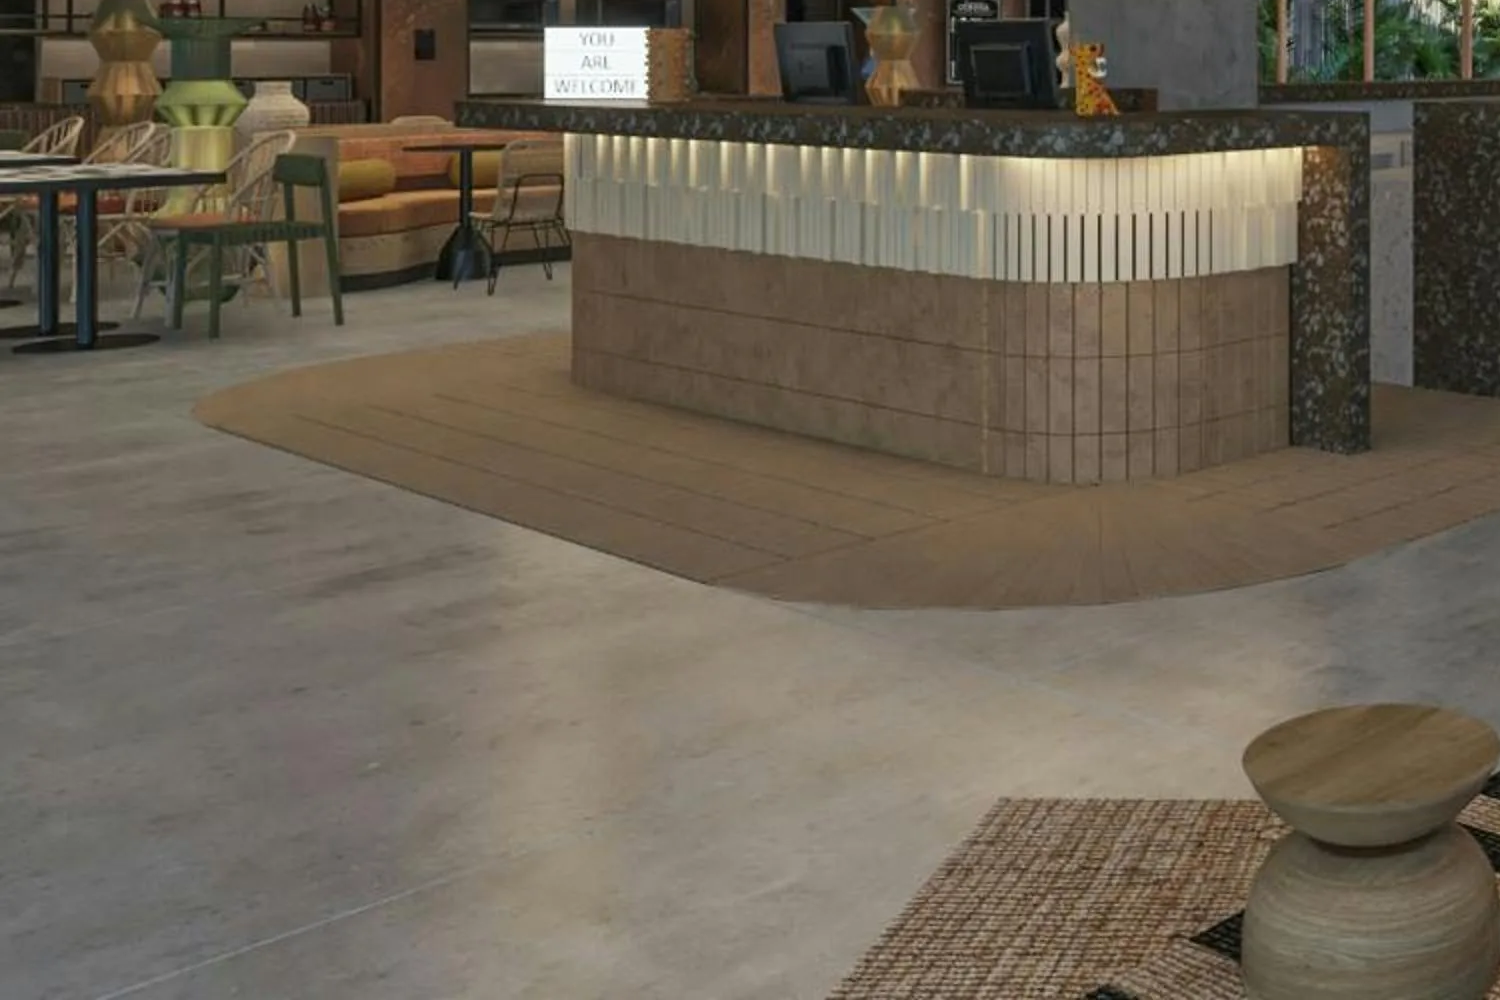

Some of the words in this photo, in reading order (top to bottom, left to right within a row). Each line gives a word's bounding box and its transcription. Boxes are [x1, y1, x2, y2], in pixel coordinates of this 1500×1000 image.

[578, 31, 616, 47] YOU
[580, 55, 611, 70] ARE
[555, 79, 637, 94] WELCOME
